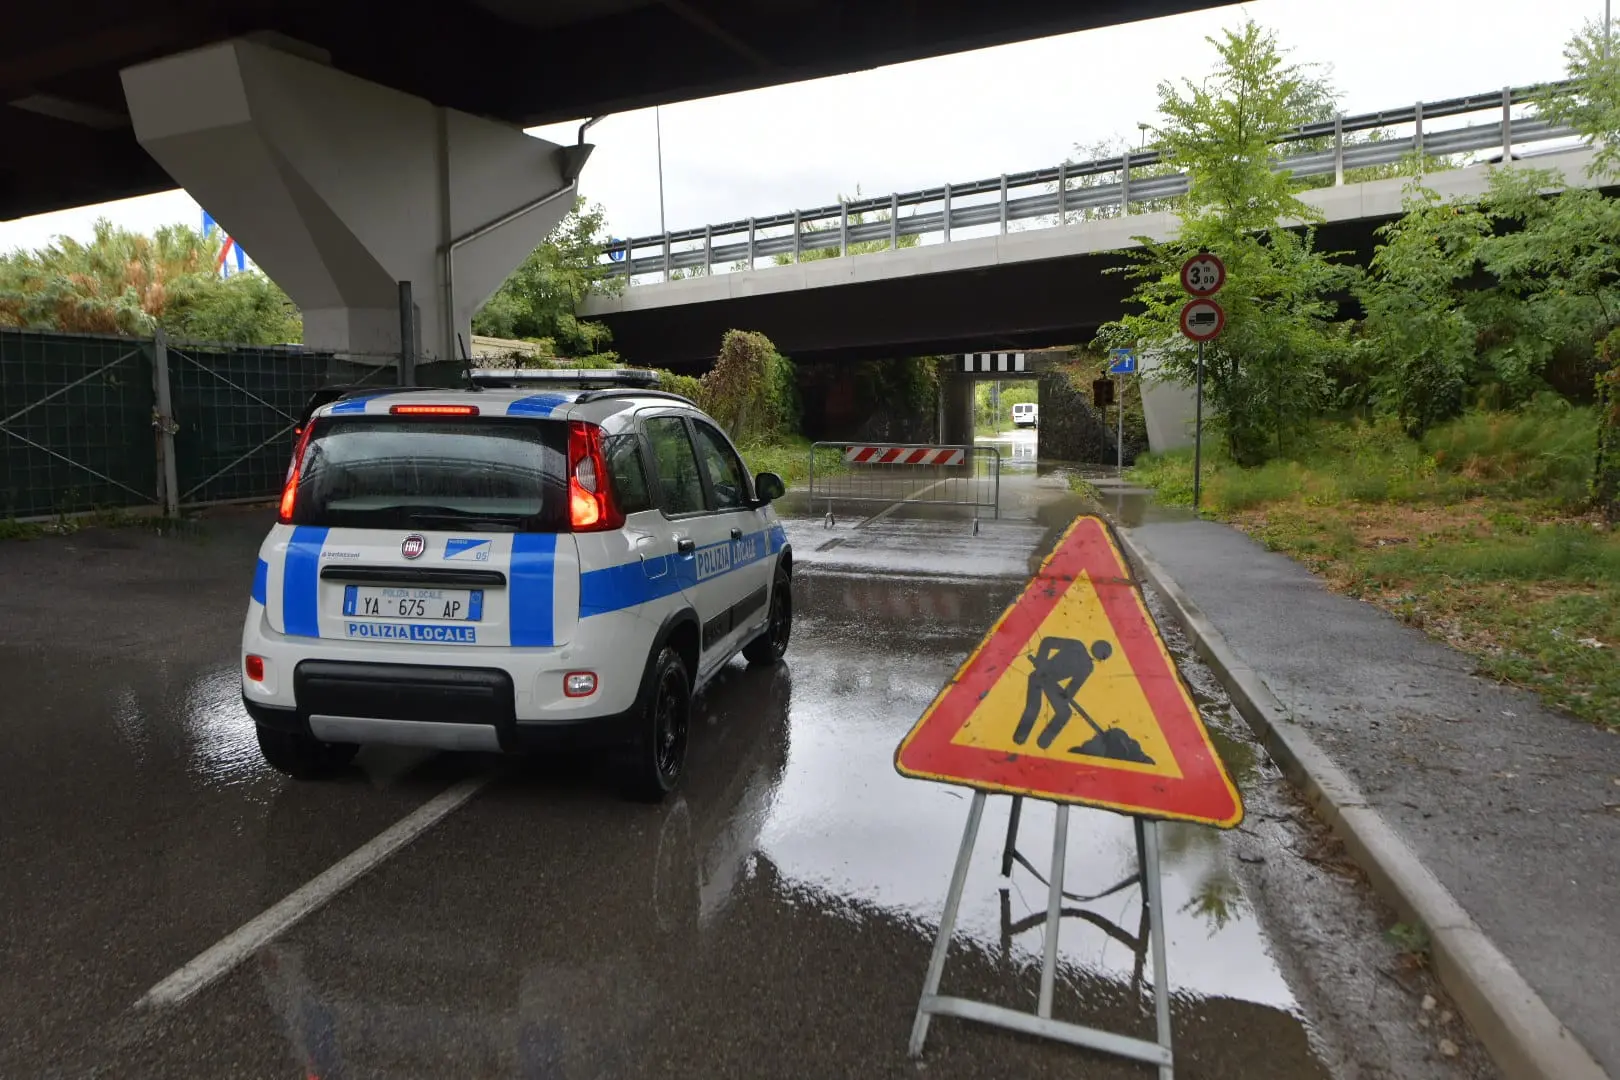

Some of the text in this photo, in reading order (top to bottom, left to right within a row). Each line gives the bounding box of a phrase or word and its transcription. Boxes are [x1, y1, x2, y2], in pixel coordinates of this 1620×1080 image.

[405, 541, 421, 553] FIAT
[698, 539, 756, 576] POLIZIA LOCALE
[382, 589, 444, 600] POLIZIA LOCALE
[364, 597, 379, 615] YA
[398, 599, 425, 617] 675
[443, 601, 461, 618] AP
[349, 623, 475, 641] POLIZIA LOCALE
